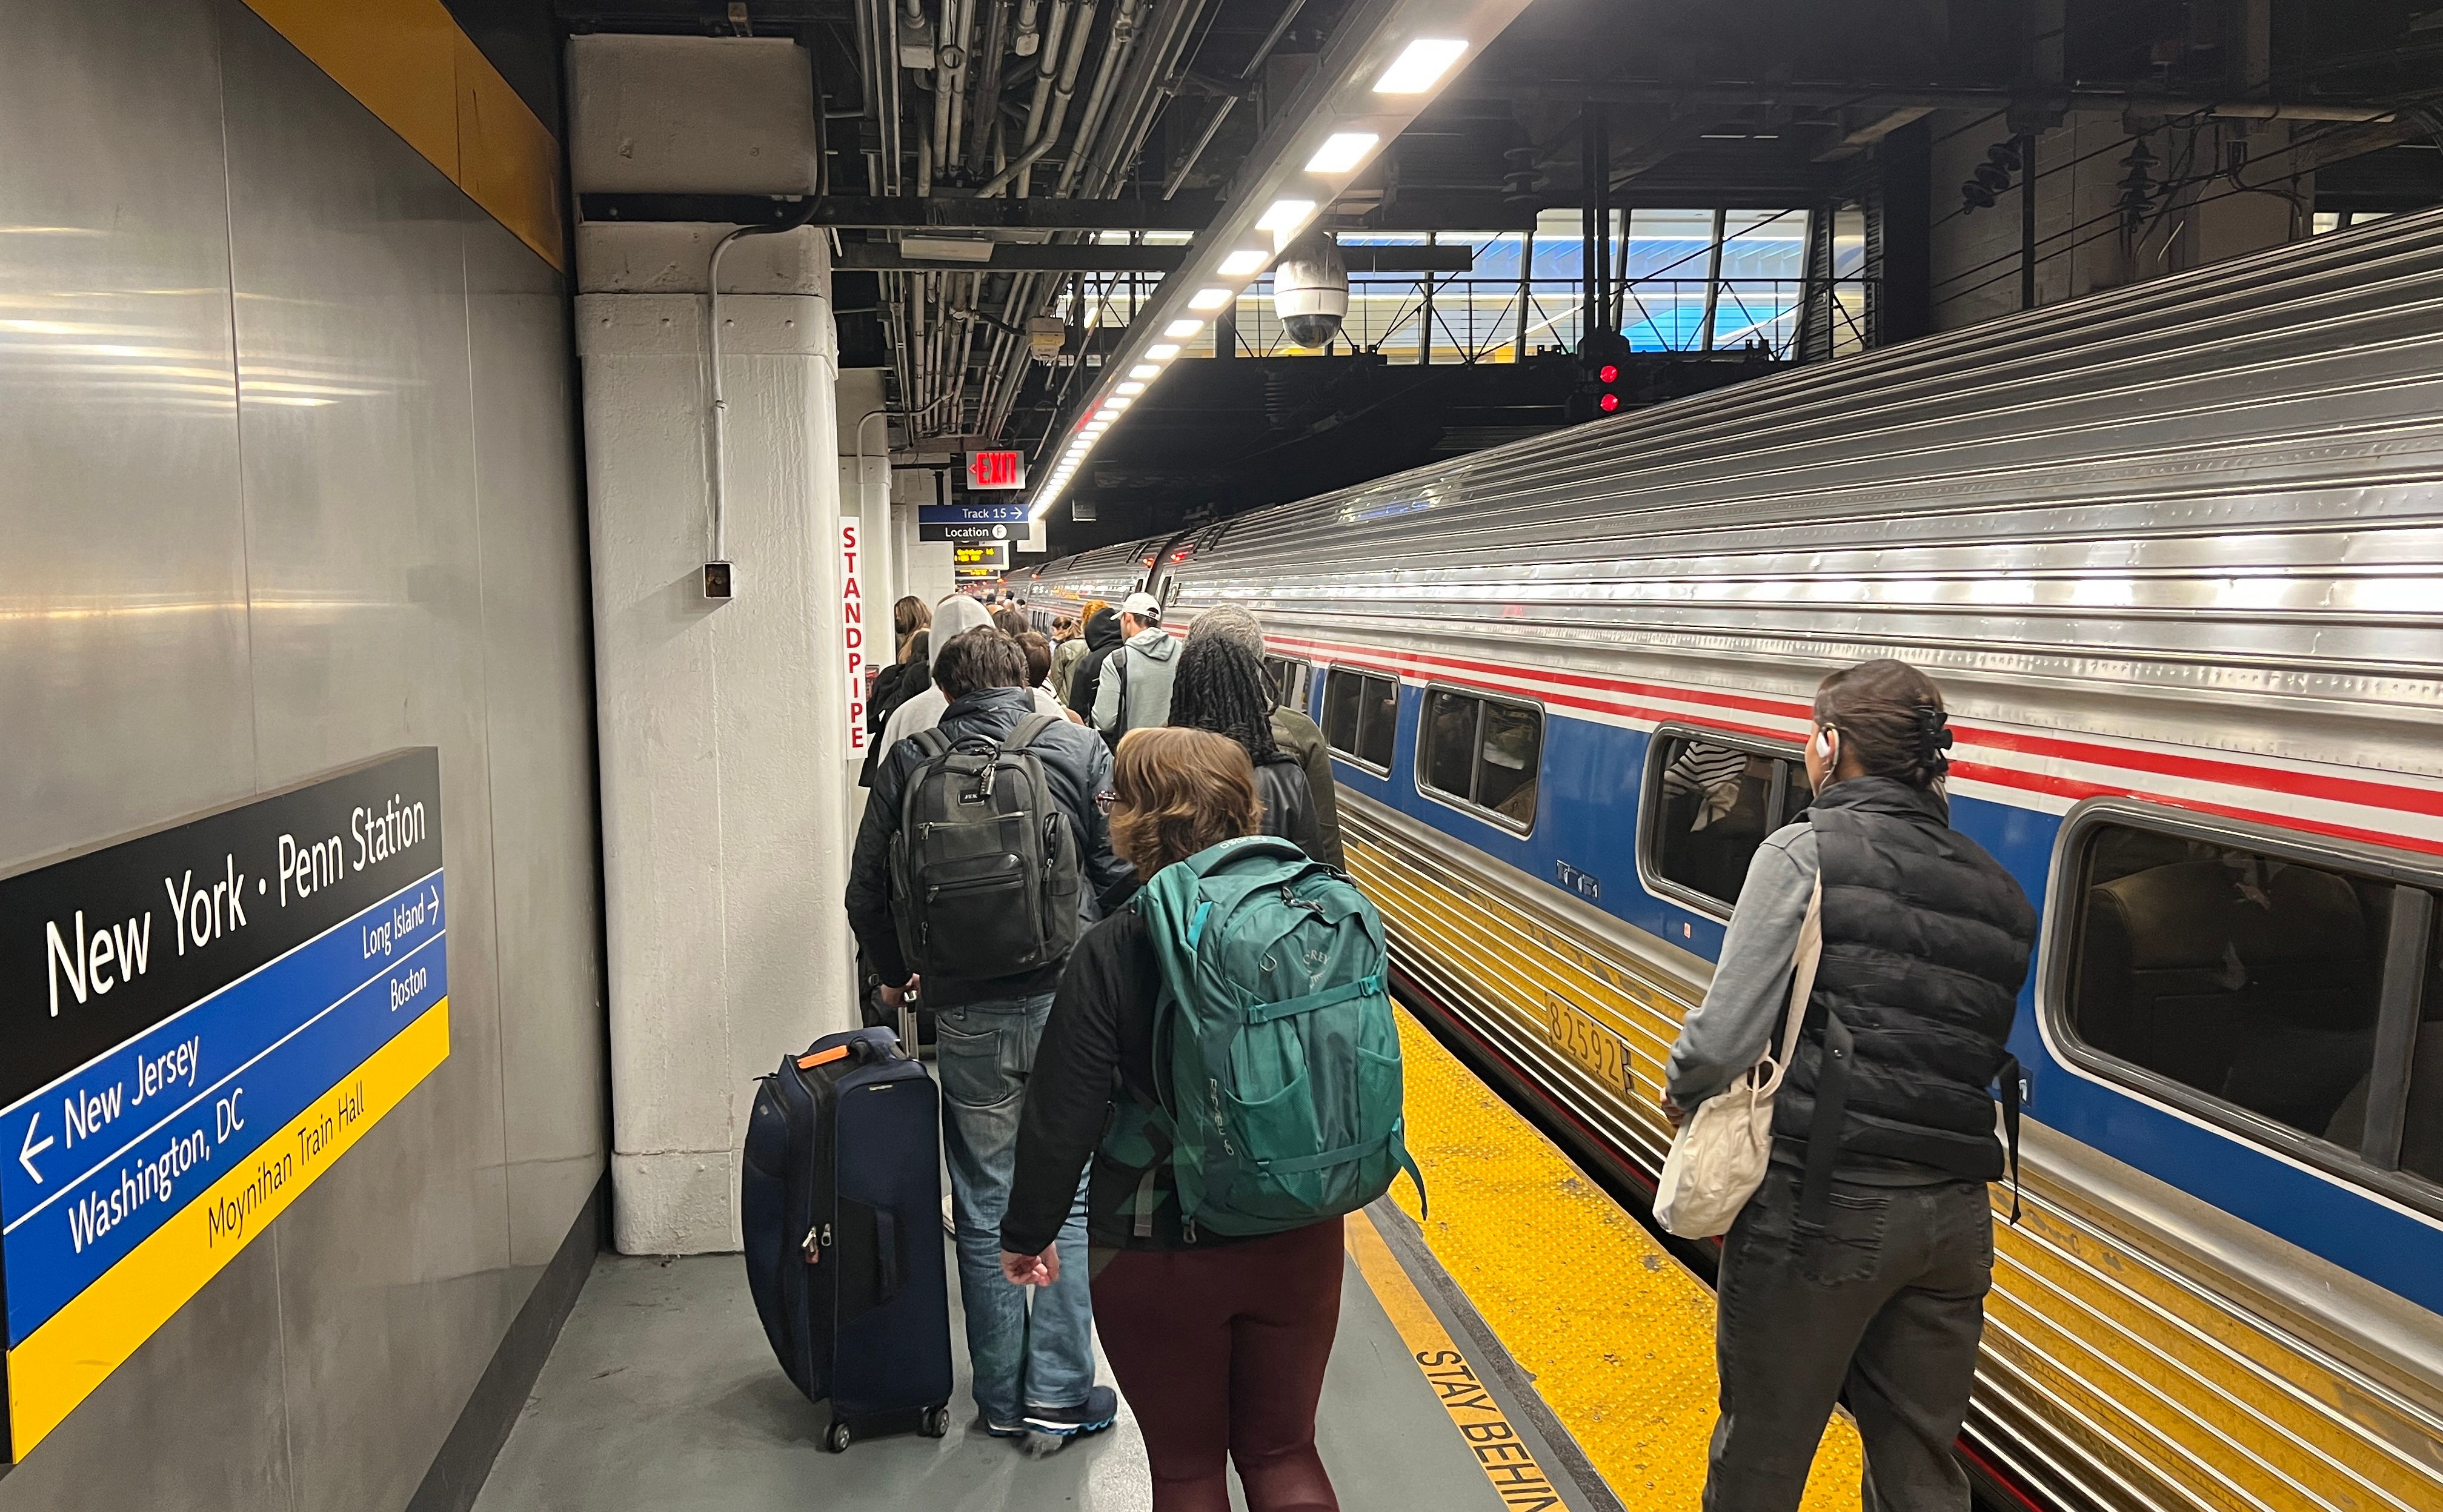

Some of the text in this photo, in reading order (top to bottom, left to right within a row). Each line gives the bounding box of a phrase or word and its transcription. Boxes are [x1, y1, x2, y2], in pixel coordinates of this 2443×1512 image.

[976, 453, 1017, 485] EXIT
[945, 527, 989, 537] Location
[962, 508, 1006, 519] Track 15
[843, 526, 864, 748] STANDPIPE
[46, 794, 425, 1018] New York Penn Station
[363, 900, 424, 959] Long Island
[390, 966, 427, 1012] Boston
[1550, 1001, 1620, 1083] 82592
[65, 1035, 199, 1149] New Jersey
[68, 1087, 245, 1254] Washington, DC
[208, 1080, 364, 1248] Moynihan Train Hall
[1415, 1350, 1497, 1413] STAY
